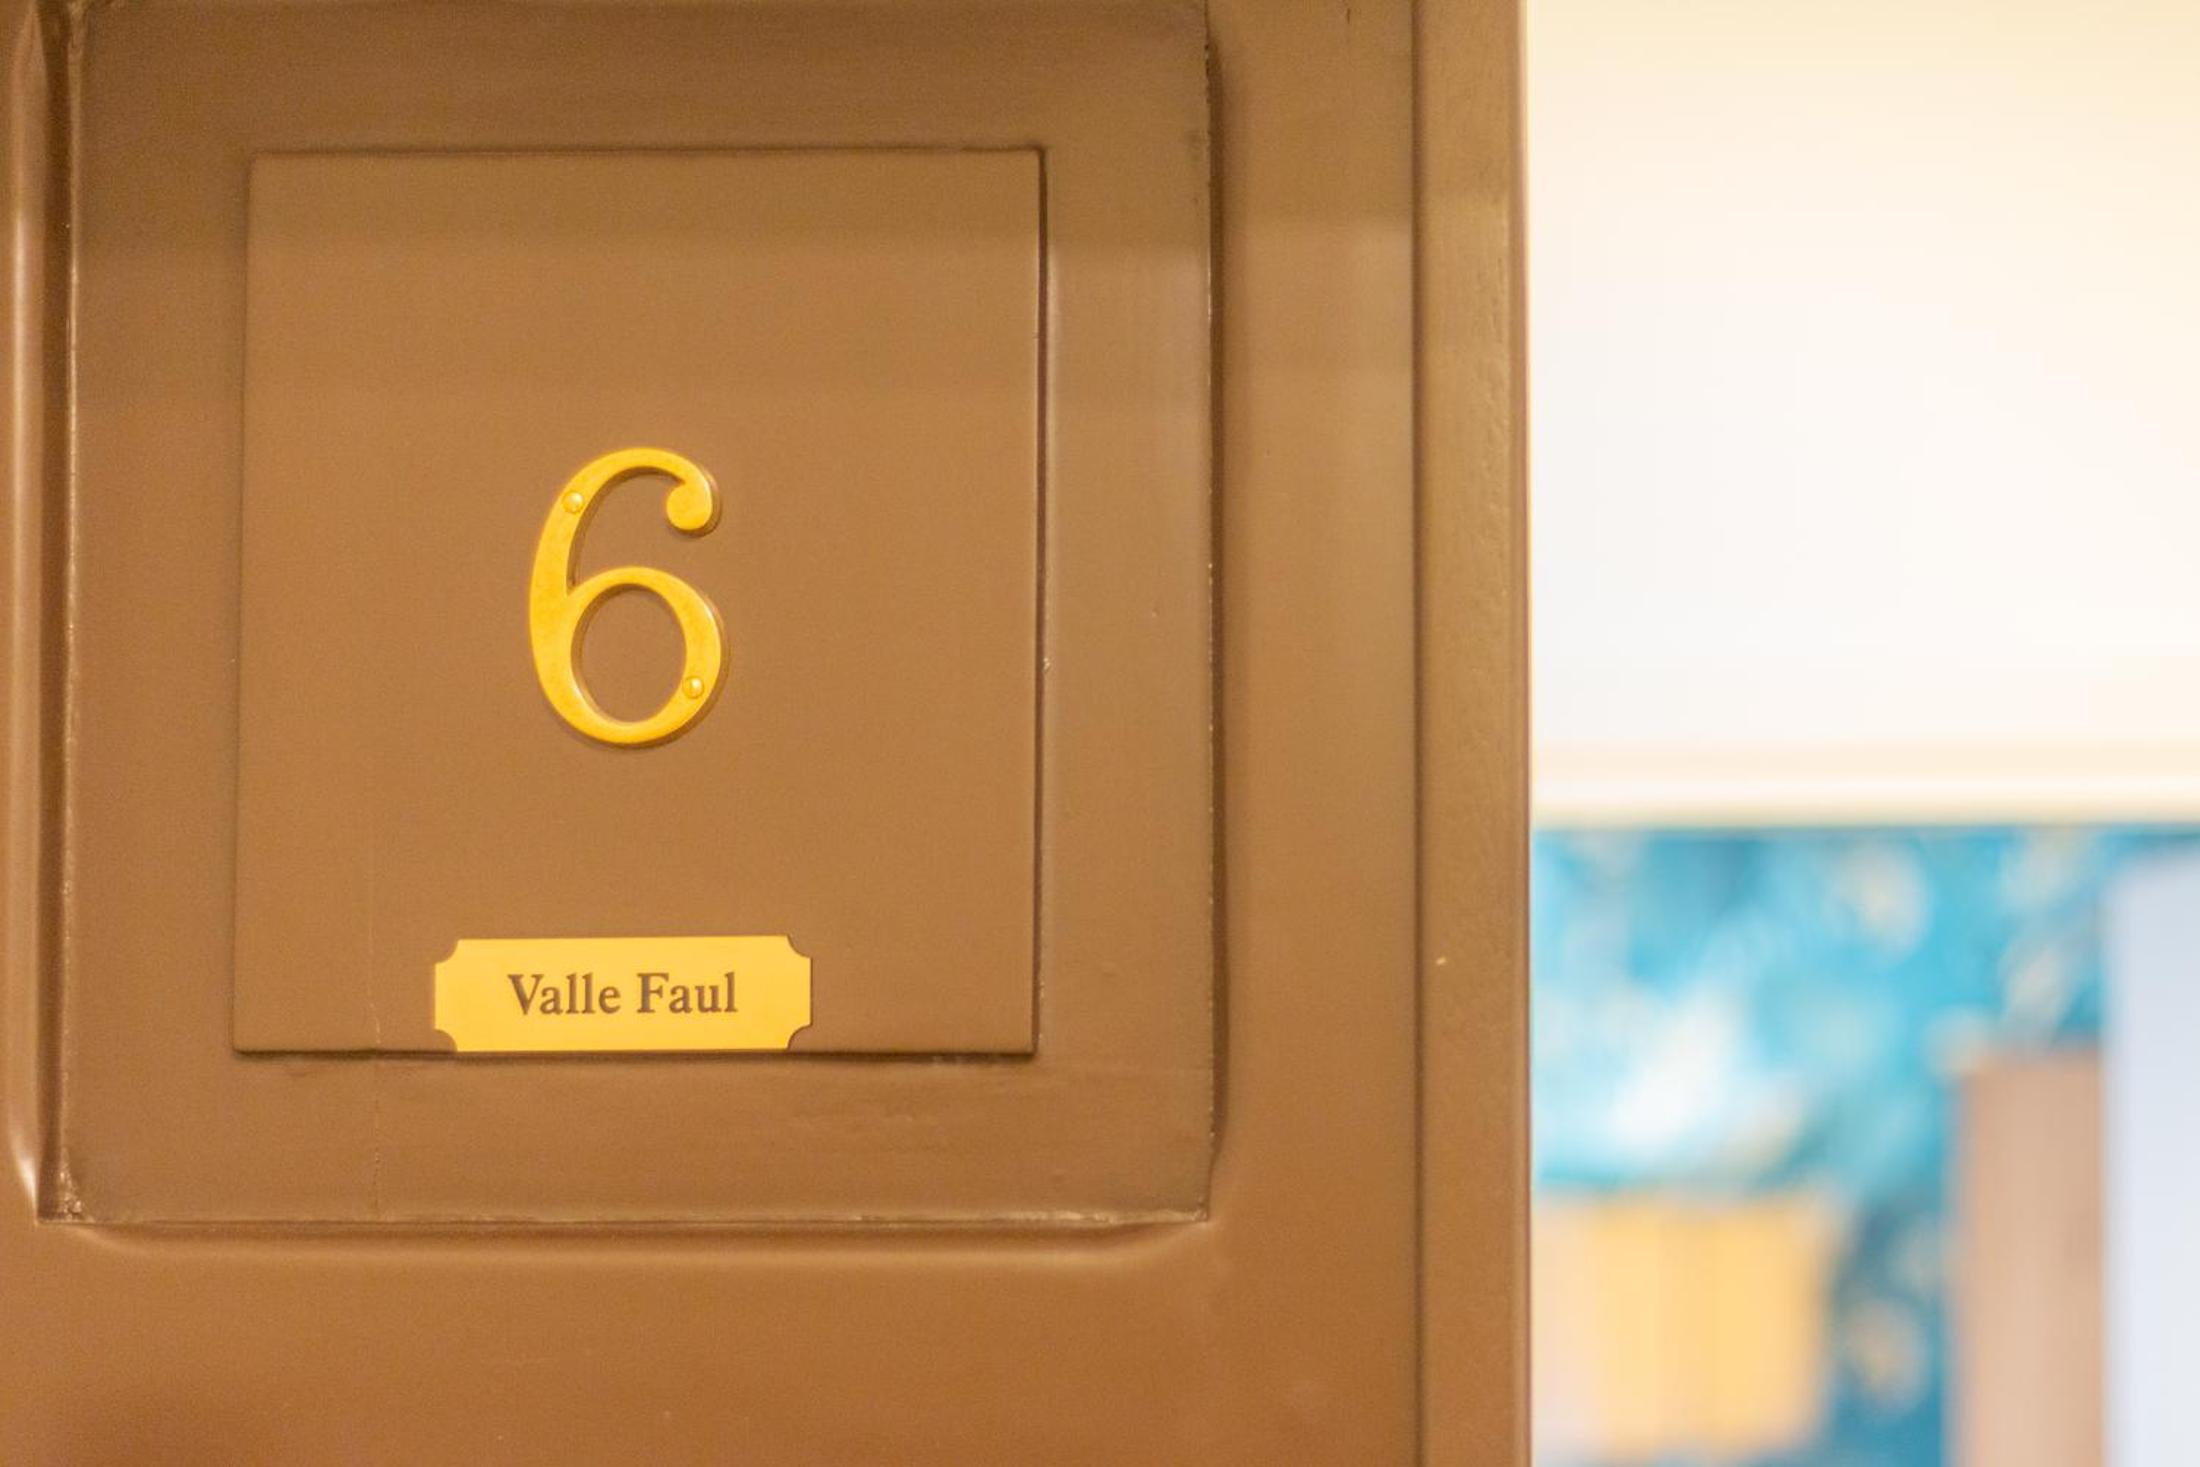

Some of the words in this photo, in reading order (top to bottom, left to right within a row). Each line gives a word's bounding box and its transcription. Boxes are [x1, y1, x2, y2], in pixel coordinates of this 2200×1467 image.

[528, 447, 726, 746] 6
[507, 972, 621, 1015] Valle
[637, 971, 738, 1014] Faul
